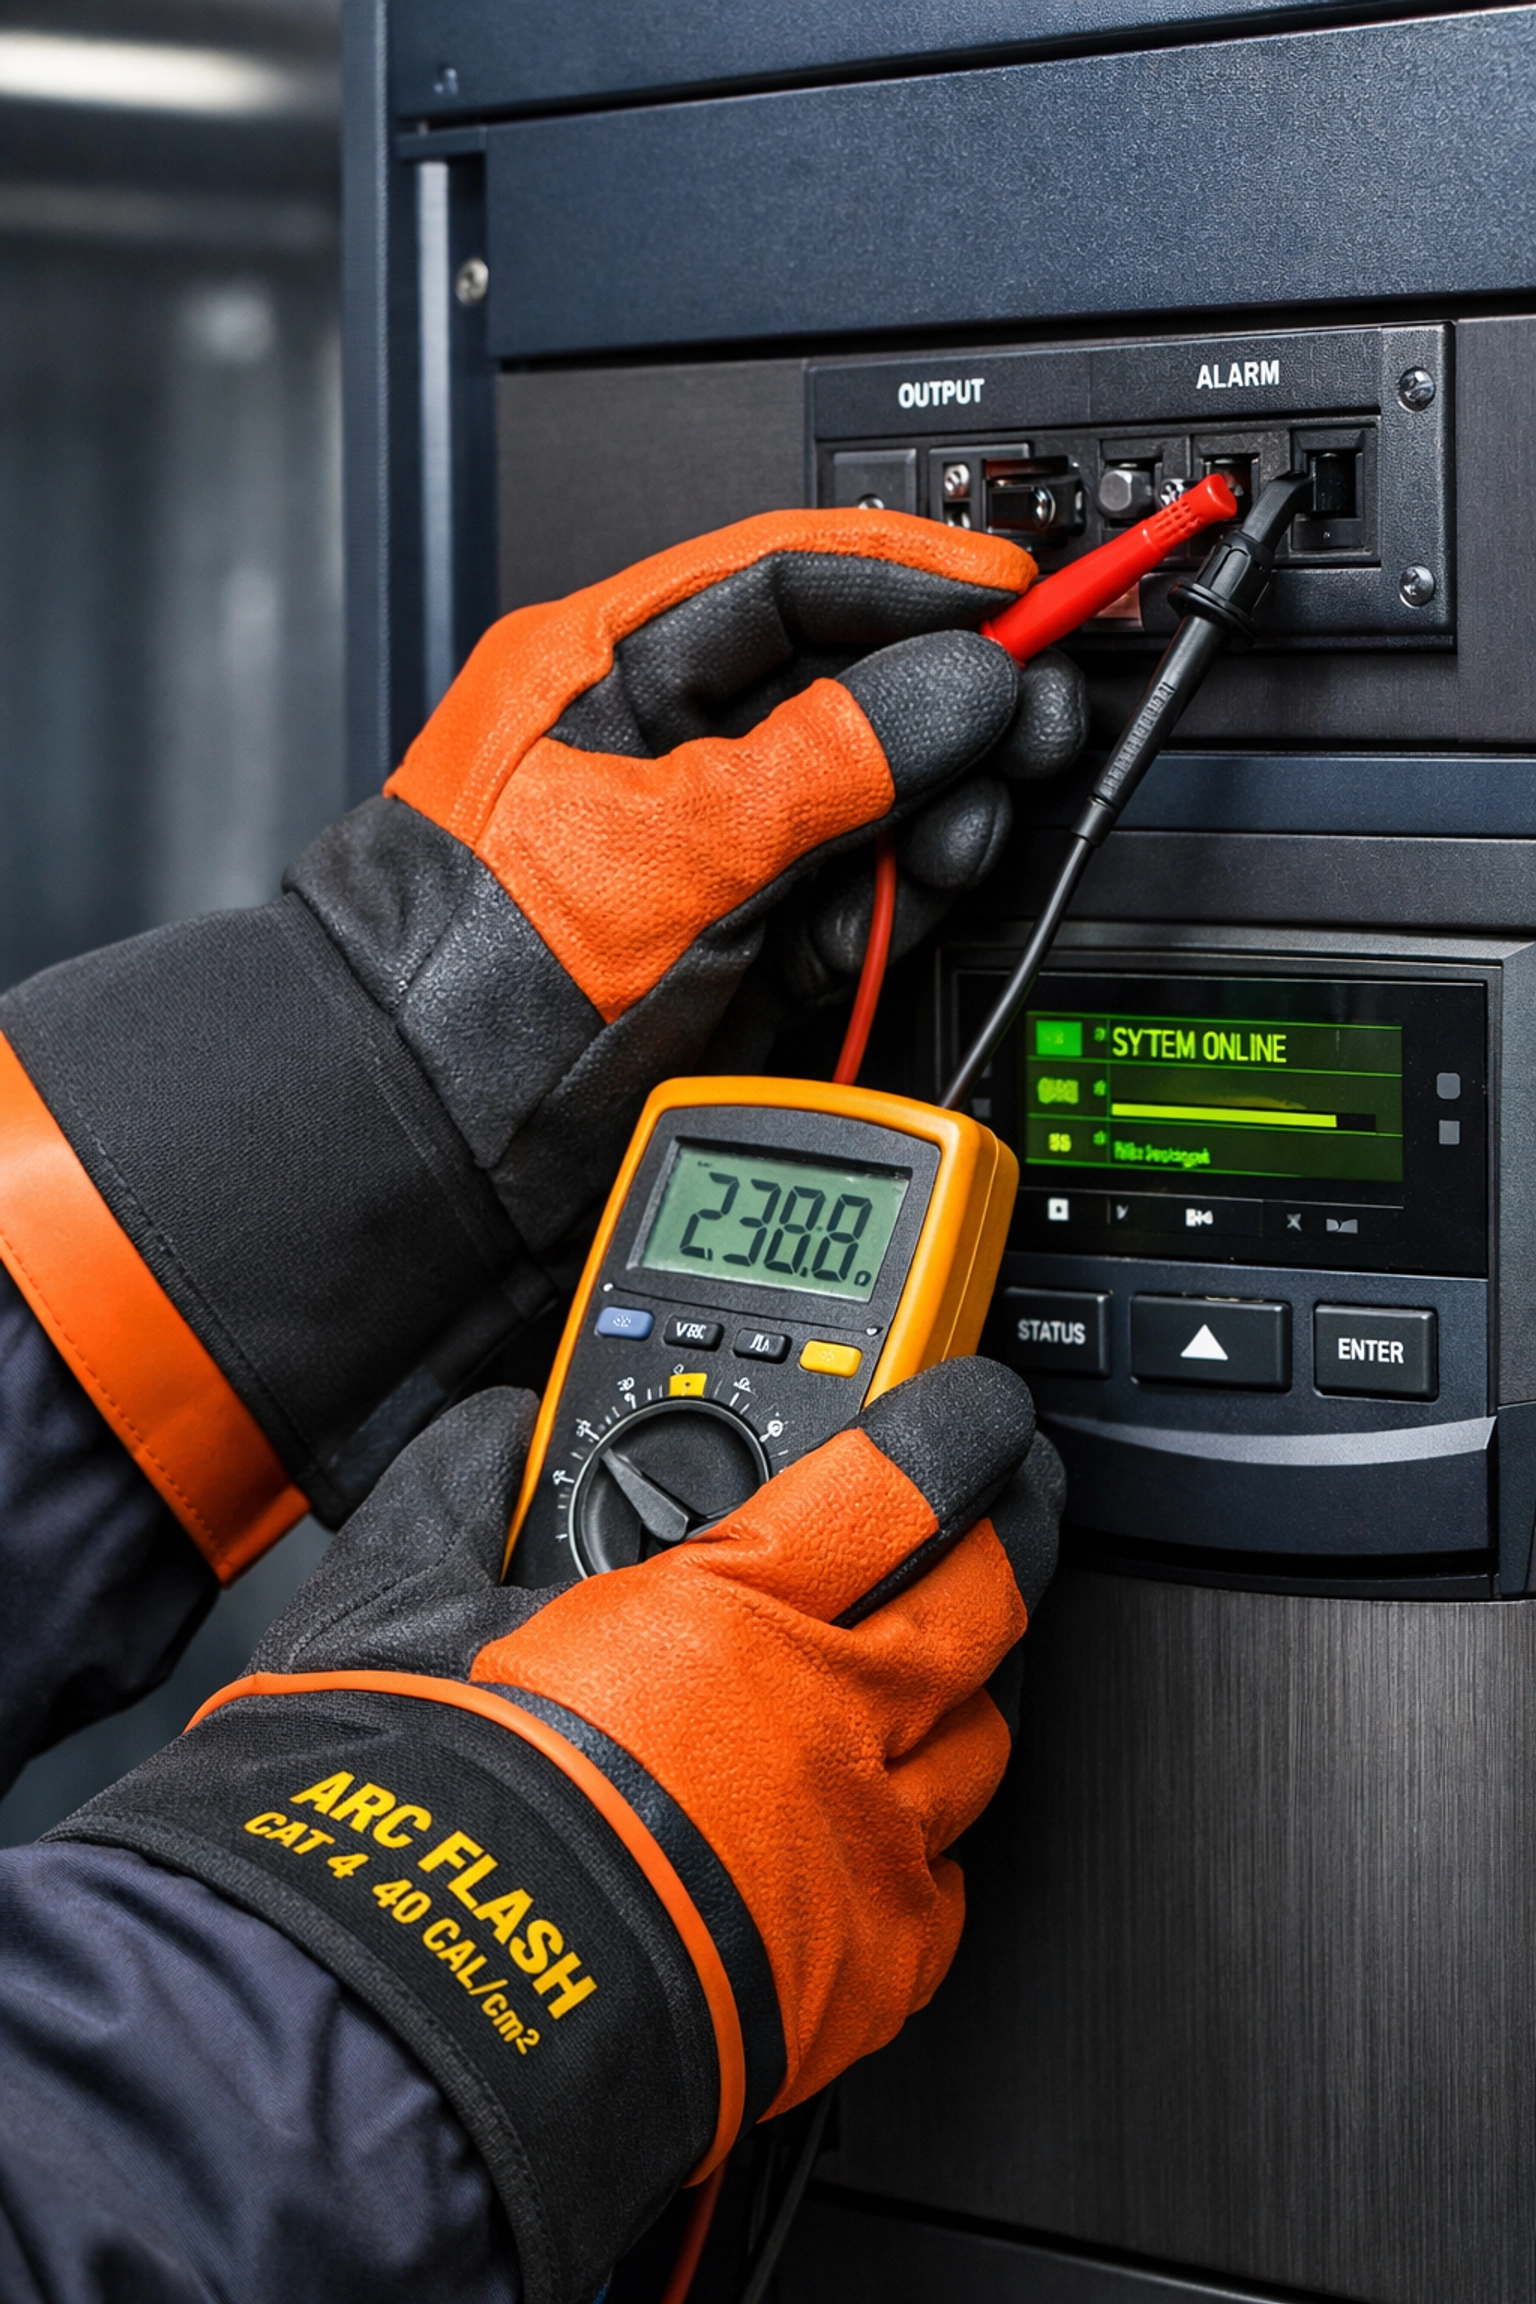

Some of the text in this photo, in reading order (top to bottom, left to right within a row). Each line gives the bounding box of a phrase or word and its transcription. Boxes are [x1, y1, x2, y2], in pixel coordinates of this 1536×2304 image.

[1195, 359, 1280, 390] ALARM
[898, 377, 985, 409] OUTPUT
[1112, 1027, 1287, 1063] SYTEM ONLINE
[1018, 1319, 1086, 1345] STATUS
[1338, 1337, 1404, 1364] ENTER
[243, 1811, 335, 1855] CAT
[327, 1852, 369, 1879] 4
[371, 1878, 432, 1924] 40
[290, 1770, 598, 2020] ARC FLASH
